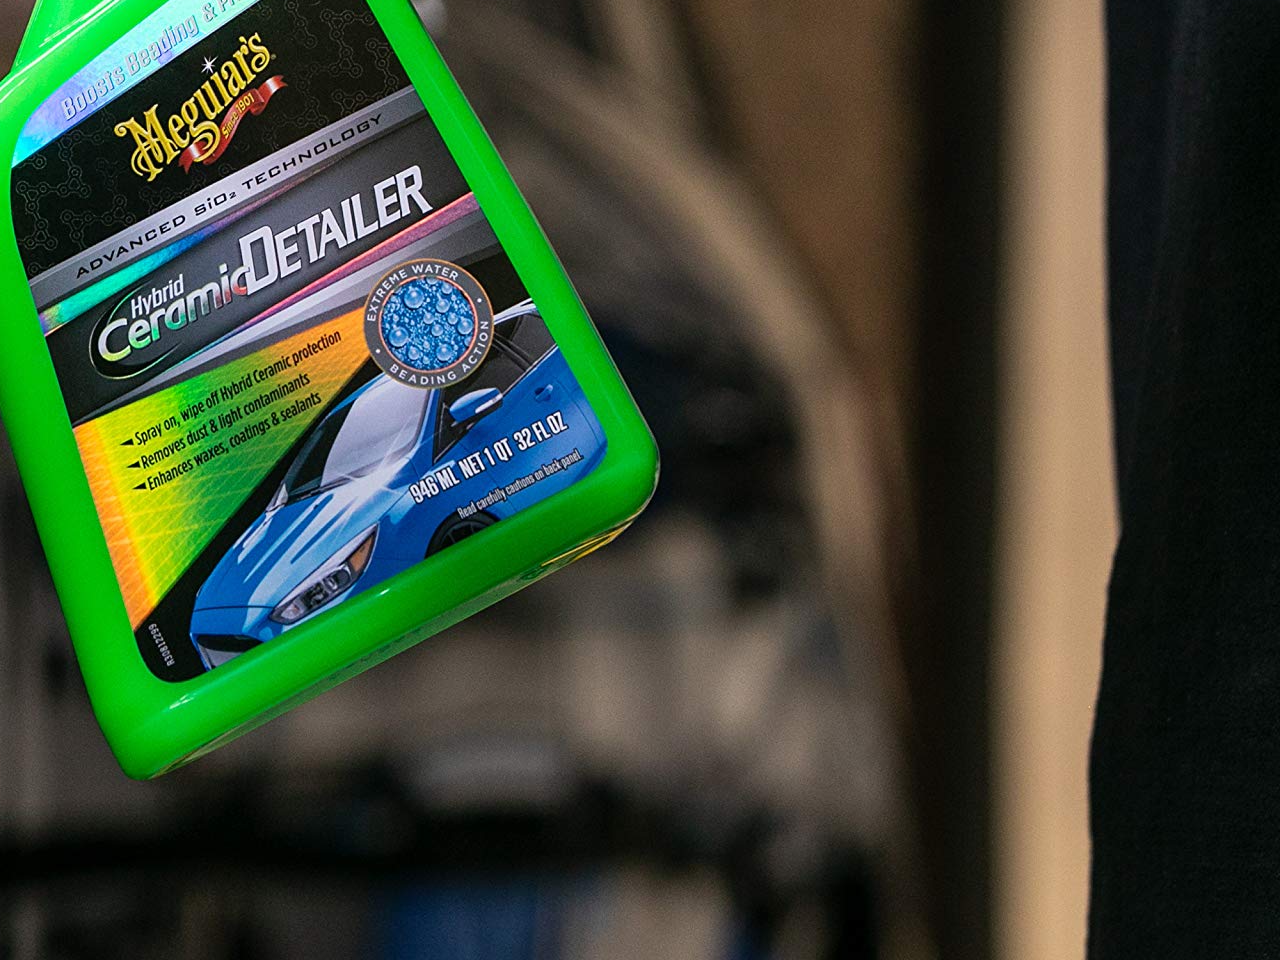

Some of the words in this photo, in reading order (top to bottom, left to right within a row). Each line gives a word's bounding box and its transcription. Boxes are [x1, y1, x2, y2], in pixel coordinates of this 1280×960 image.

[61, 65, 125, 121] Boosts
[124, 15, 200, 76] Beading
[202, 3, 218, 23] &
[114, 32, 270, 182] Meguiar's
[221, 114, 239, 139] Since
[235, 92, 255, 114] 1901
[76, 215, 186, 279] ADVANCED
[242, 113, 383, 190] TECHNOLOGY
[98, 263, 250, 362] Ceramic
[238, 165, 433, 295] DETAILER
[130, 274, 184, 319] Hybrid
[367, 269, 408, 321] EXTREME
[412, 264, 459, 281] WATER
[135, 424, 162, 445] Spray
[164, 415, 181, 431] on,
[180, 401, 205, 422] wipe
[205, 392, 220, 410] off
[220, 375, 253, 403] Hybrid
[253, 356, 292, 384] Ceramic
[292, 330, 342, 367] protection
[389, 363, 457, 385] BEADING
[462, 321, 489, 373] ACTION
[141, 439, 186, 469] Removes
[187, 423, 209, 445] dust
[209, 419, 219, 433] &
[219, 406, 243, 429] light
[243, 372, 311, 416] contaminants
[148, 460, 193, 491] Enhances
[194, 443, 229, 467] waxes,
[229, 418, 271, 449] coatings
[271, 412, 281, 426] &
[280, 392, 322, 421] sealants
[409, 476, 439, 504] 946
[436, 465, 460, 491] ML
[458, 452, 486, 479] NET
[483, 447, 496, 467] 1
[494, 438, 514, 462] QT
[513, 427, 536, 451] 32
[532, 421, 551, 442] FL
[547, 410, 569, 435] OZ
[457, 501, 477, 519] Read
[476, 486, 507, 510] carefully
[505, 474, 535, 495] cautions
[535, 469, 544, 481] on
[543, 459, 562, 476] back
